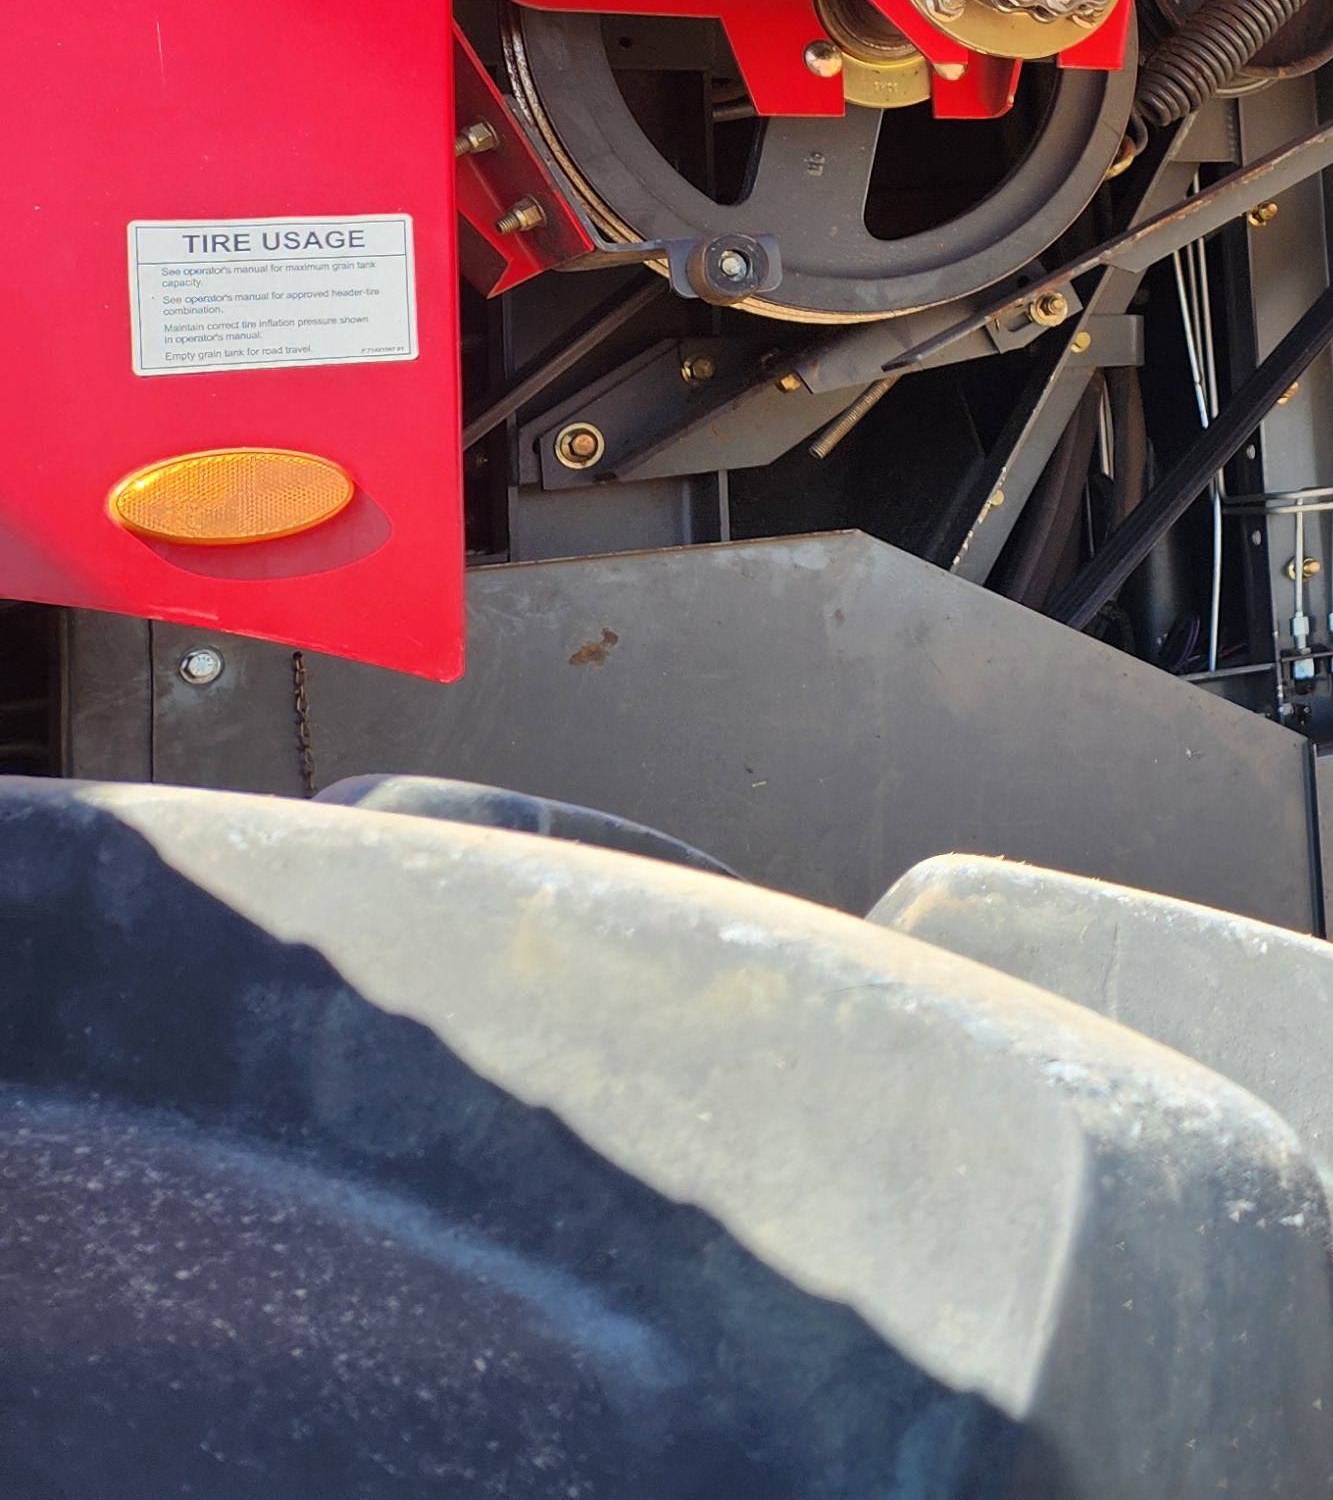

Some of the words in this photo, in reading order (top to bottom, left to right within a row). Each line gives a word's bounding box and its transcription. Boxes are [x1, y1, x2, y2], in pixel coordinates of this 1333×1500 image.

[182, 233, 251, 254] TIRE
[262, 230, 366, 251] USAGE
[161, 267, 181, 277] See
[183, 266, 232, 277] operator's
[233, 264, 268, 274] manual
[270, 264, 283, 272] for
[285, 263, 330, 271] maximum
[332, 262, 354, 272] grain
[357, 261, 377, 269] tank
[162, 278, 204, 289] capacity.
[162, 295, 182, 305] See
[184, 294, 233, 305] operator's
[234, 292, 269, 301] manual
[271, 291, 284, 300] for
[286, 290, 330, 301] approved
[331, 288, 380, 297] header-tire
[163, 306, 224, 316] combination.
[164, 323, 205, 333] Maintain
[207, 321, 240, 330] correct
[241, 320, 257, 329] tire
[259, 318, 295, 328] inflation
[297, 317, 338, 328] pressure
[340, 316, 369, 324] shown
[164, 335, 173, 344] in
[175, 333, 224, 345] operator's
[225, 331, 263, 341] manual.
[165, 351, 196, 362] Empty
[197, 349, 222, 360] grain
[224, 348, 245, 358] tank
[246, 347, 260, 356] for
[262, 346, 284, 355] road
[285, 344, 313, 354] travel.
